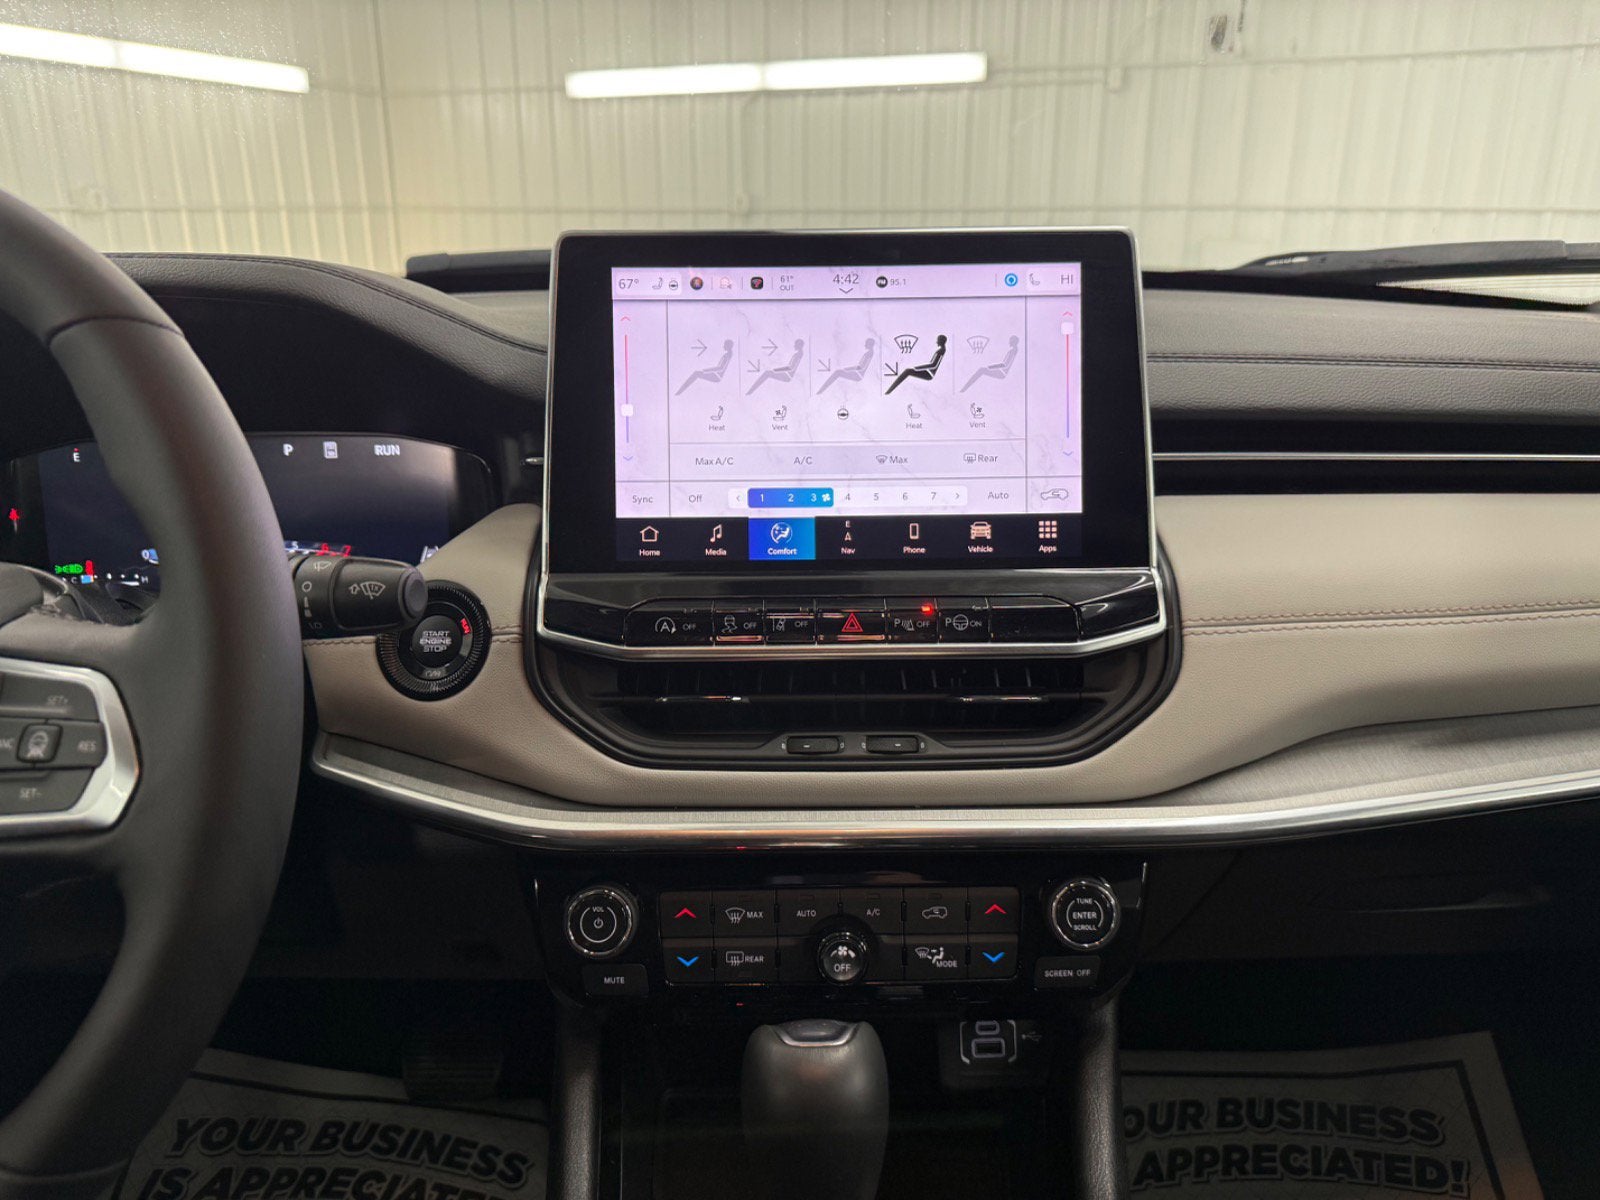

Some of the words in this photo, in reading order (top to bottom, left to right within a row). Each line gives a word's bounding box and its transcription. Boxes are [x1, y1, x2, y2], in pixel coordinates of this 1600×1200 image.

[618, 278, 639, 289] 67°
[832, 273, 859, 285] 4:42
[1060, 275, 1074, 285] HI
[708, 423, 725, 431] Heat
[283, 443, 294, 456] P
[374, 444, 400, 456] RUN
[695, 456, 714, 466] Max
[715, 456, 734, 466] A/C
[793, 456, 813, 465] A/C
[889, 455, 908, 464] Max
[977, 454, 998, 463] Rear
[632, 494, 653, 504] Sync
[688, 494, 703, 503] Off
[759, 493, 765, 502] 1
[787, 493, 794, 502] 2
[810, 493, 817, 502] 3
[844, 492, 851, 501] 4
[873, 492, 879, 501] 5
[902, 492, 908, 501] 6
[930, 492, 937, 501] 7
[987, 491, 1009, 500] Auto
[705, 547, 727, 556] Media
[767, 547, 797, 556] Comfort
[840, 547, 856, 555] Nav
[903, 546, 926, 554] Phone
[967, 545, 993, 553] Vehicle
[1038, 545, 1057, 553] Apps
[682, 623, 696, 631] OFF
[945, 618, 952, 627] P
[746, 911, 764, 919] MAX
[796, 910, 816, 918] AUTO
[866, 908, 881, 917] A/C
[1072, 911, 1098, 920] ENTER
[744, 955, 765, 963] REAR
[834, 963, 852, 972] OFF
[936, 960, 958, 968] MODE
[1044, 969, 1073, 978] SCREEN
[1076, 969, 1091, 977] OFF
[603, 977, 625, 985] MUTE
[1123, 1098, 1206, 1139] OUR
[1215, 1097, 1444, 1145] BUSINESS
[170, 1117, 307, 1154] YOUR
[309, 1119, 531, 1185] BUSINESS
[1131, 1143, 1468, 1196] APPRECIATED!
[137, 1166, 192, 1200] IS
